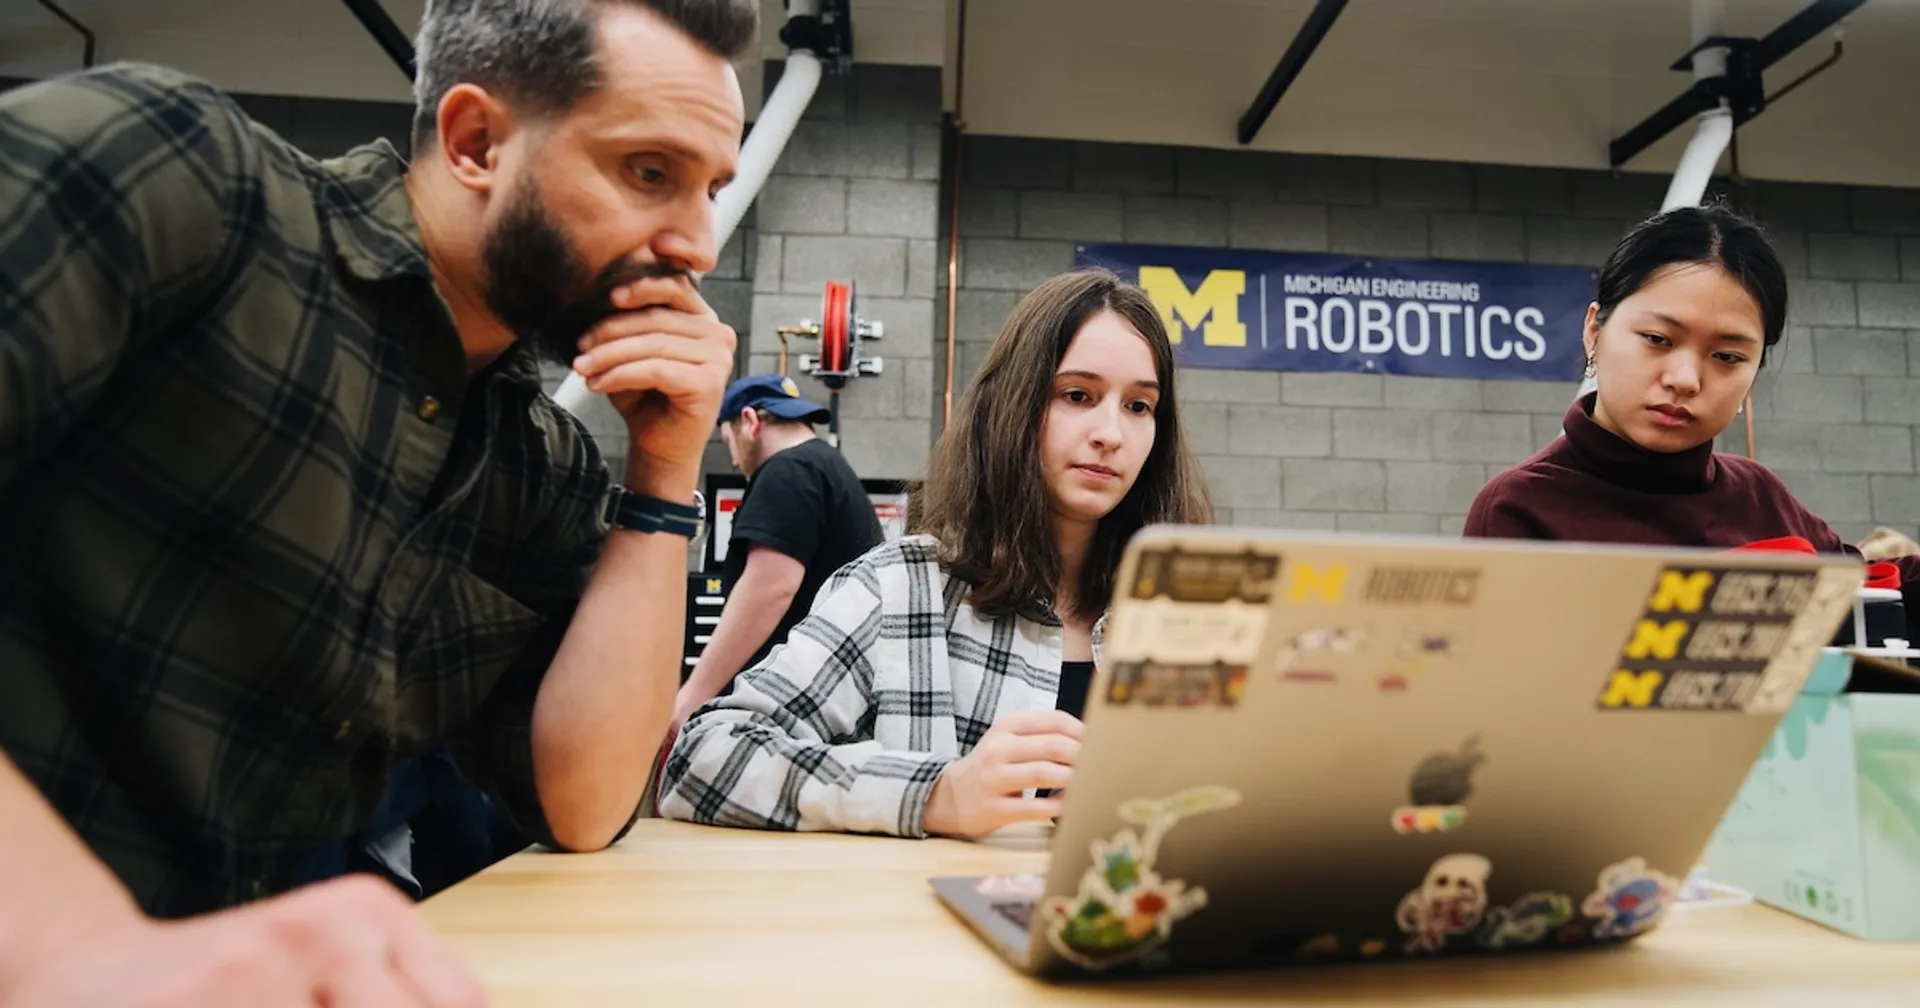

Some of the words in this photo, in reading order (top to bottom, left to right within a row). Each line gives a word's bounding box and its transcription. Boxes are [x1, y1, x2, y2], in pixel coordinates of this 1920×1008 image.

[1139, 266, 1246, 347] M
[1284, 275, 1370, 296] MICHIGAN
[1371, 279, 1480, 302] ENGINEERING
[1285, 298, 1547, 361] ROBOTICS
